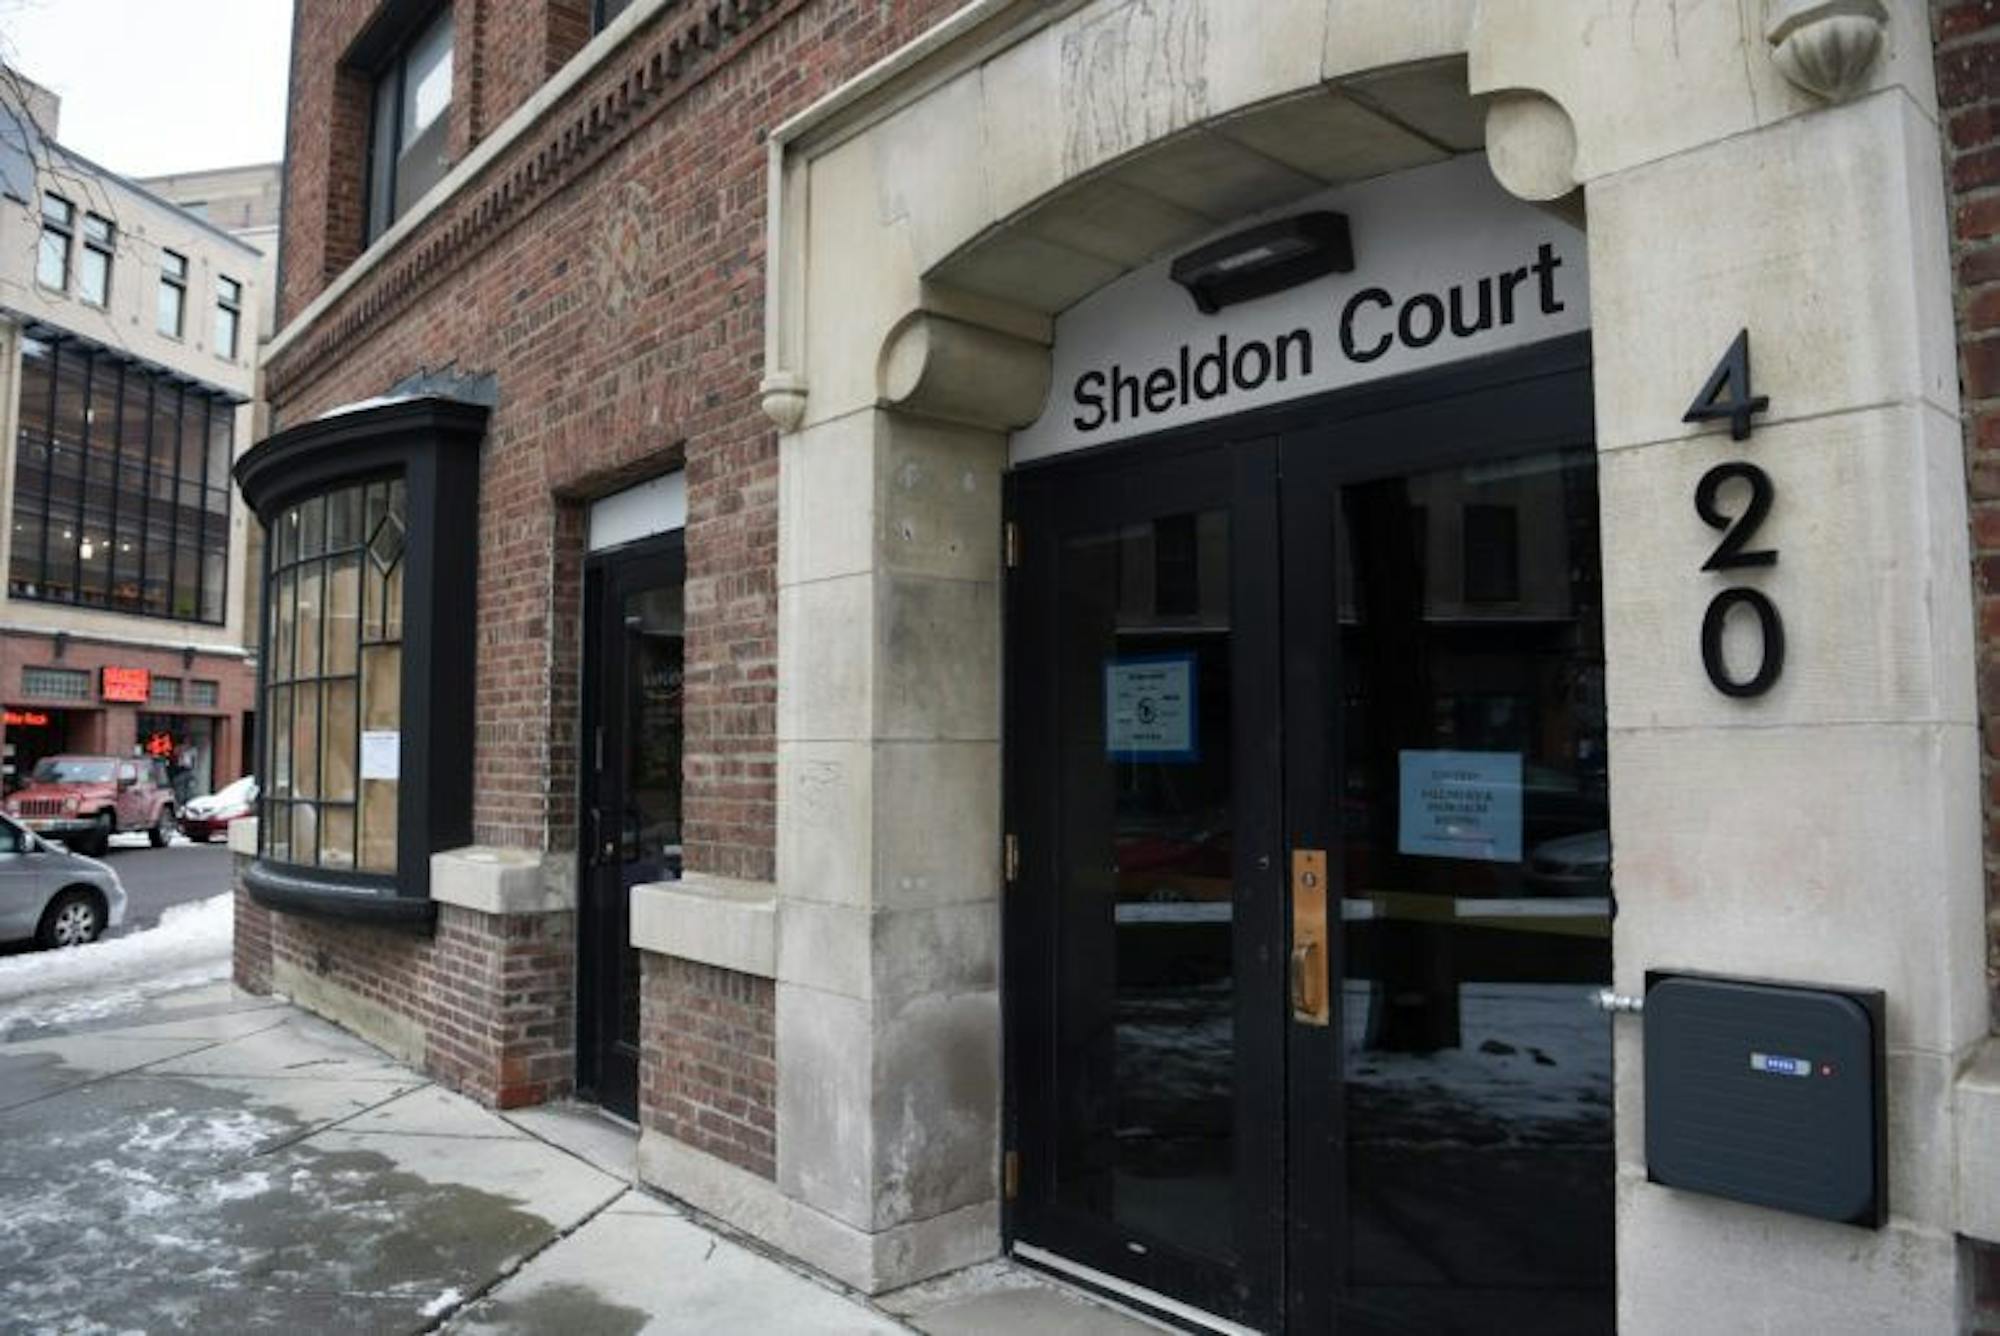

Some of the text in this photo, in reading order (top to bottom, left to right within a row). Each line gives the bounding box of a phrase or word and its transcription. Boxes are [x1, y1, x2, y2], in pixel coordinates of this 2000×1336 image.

[1073, 243, 1565, 432] Sheldon Court
[1681, 328, 1785, 698] 420
